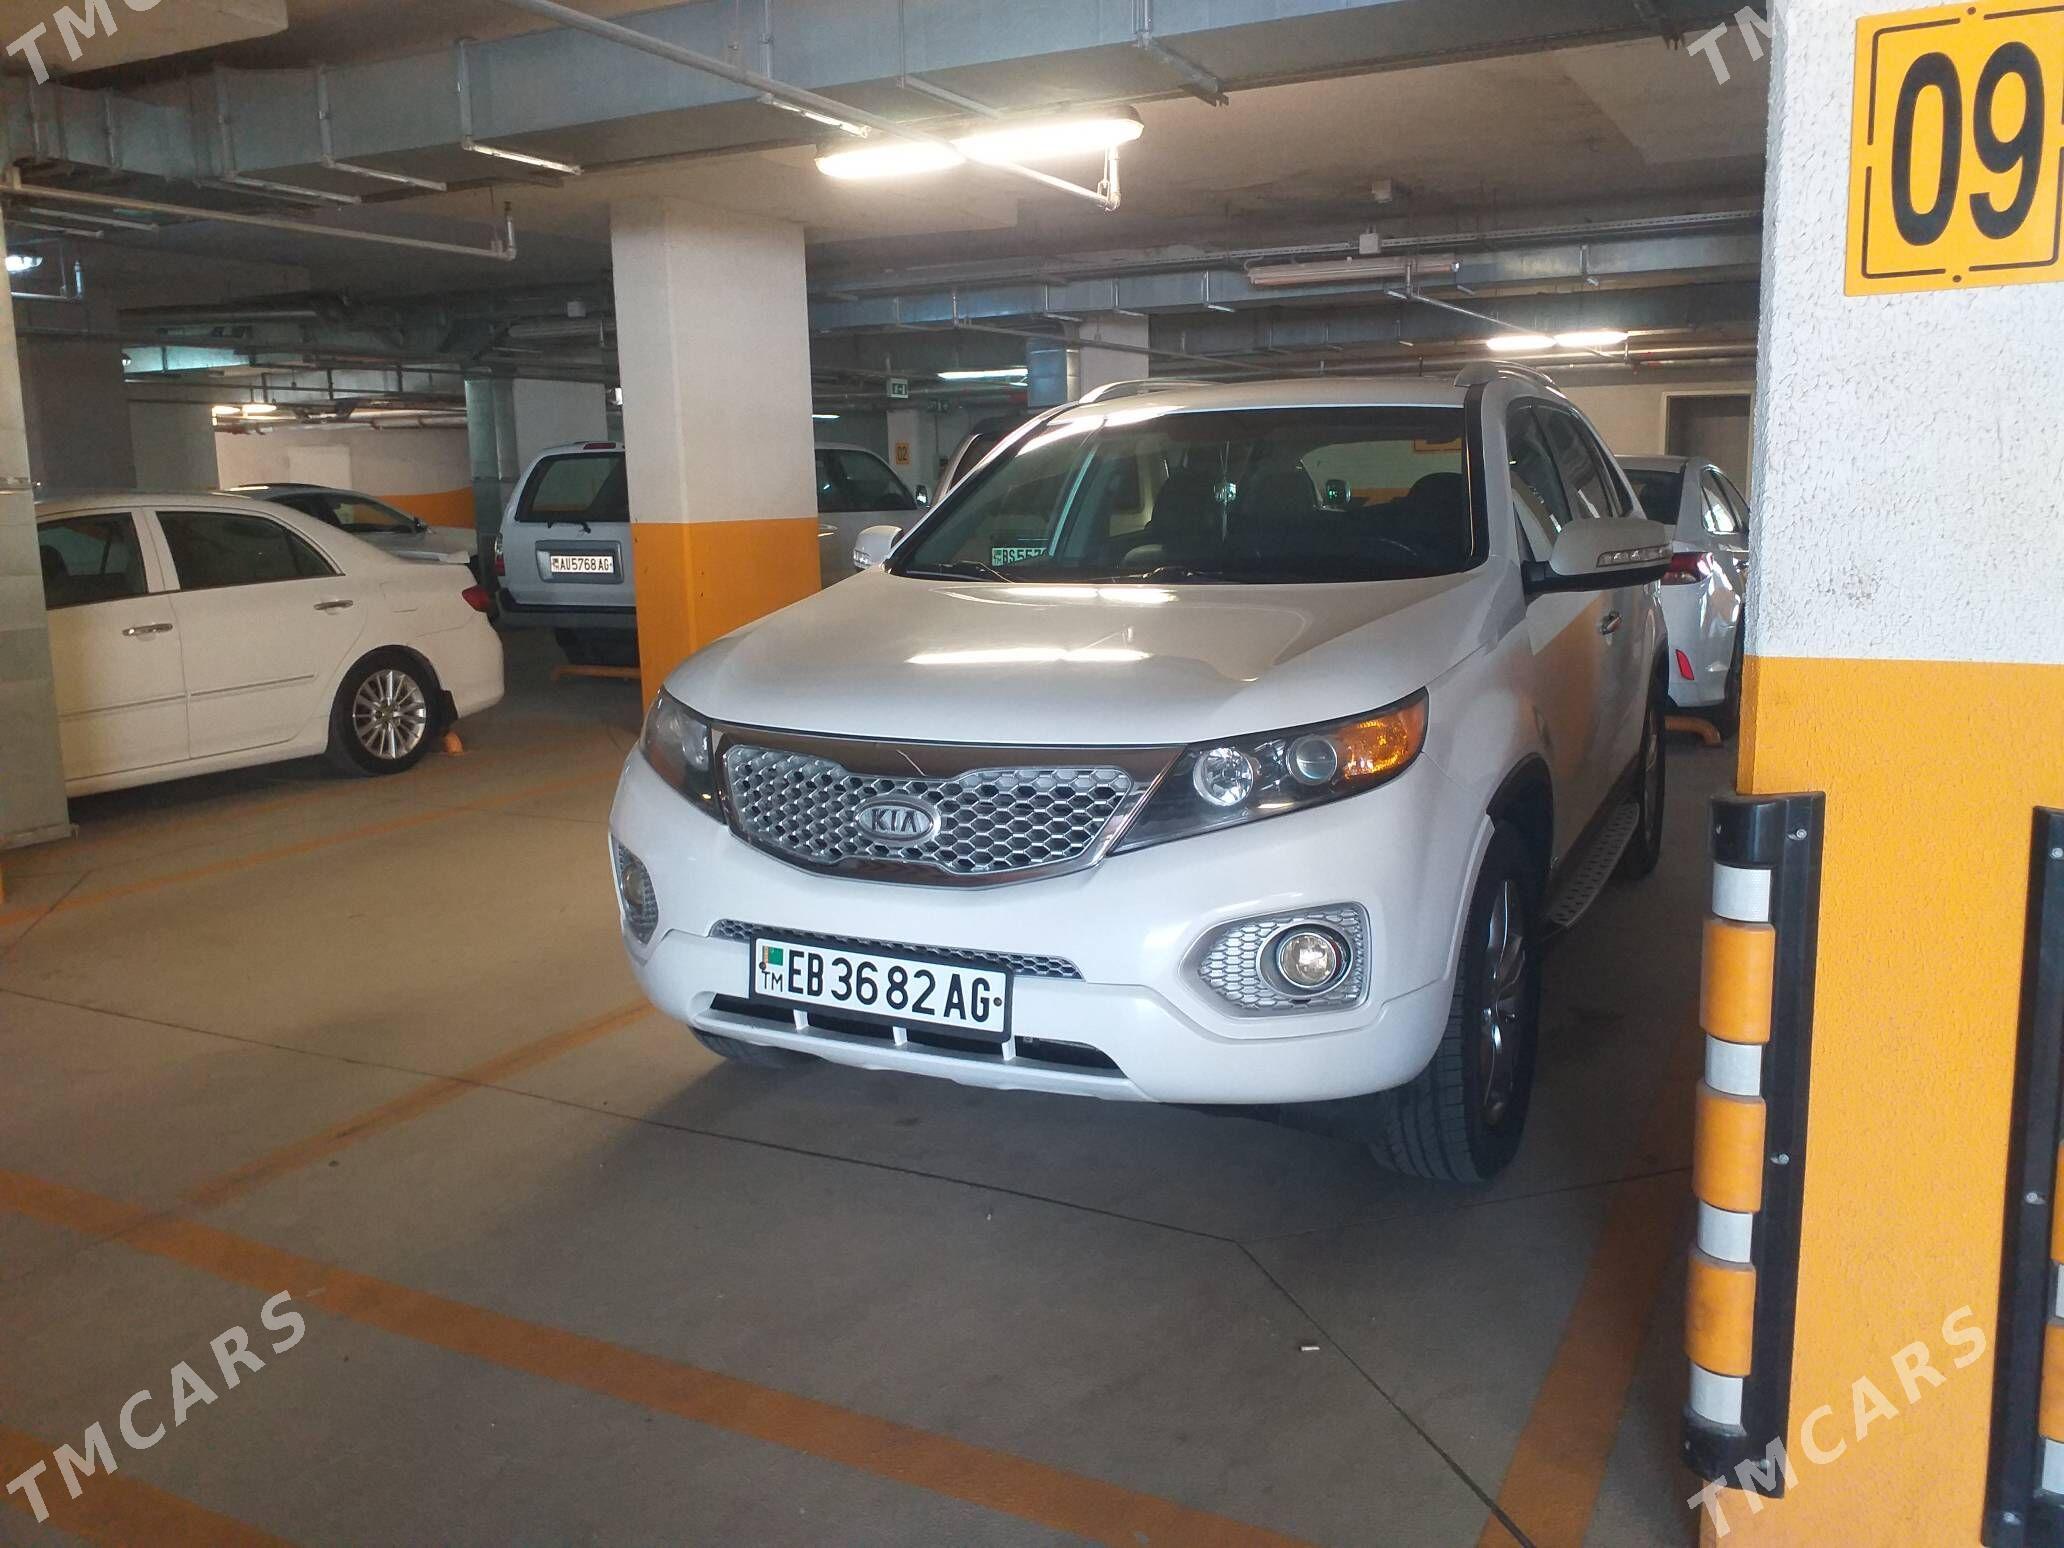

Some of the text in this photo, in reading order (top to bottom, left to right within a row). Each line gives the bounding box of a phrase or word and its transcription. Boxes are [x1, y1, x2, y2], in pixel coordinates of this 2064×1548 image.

[1892, 41, 2045, 246] 09
[897, 446, 908, 462] 02
[560, 558, 609, 571] AU5768AG
[871, 808, 919, 832] KIA
[762, 971, 783, 992] TM
